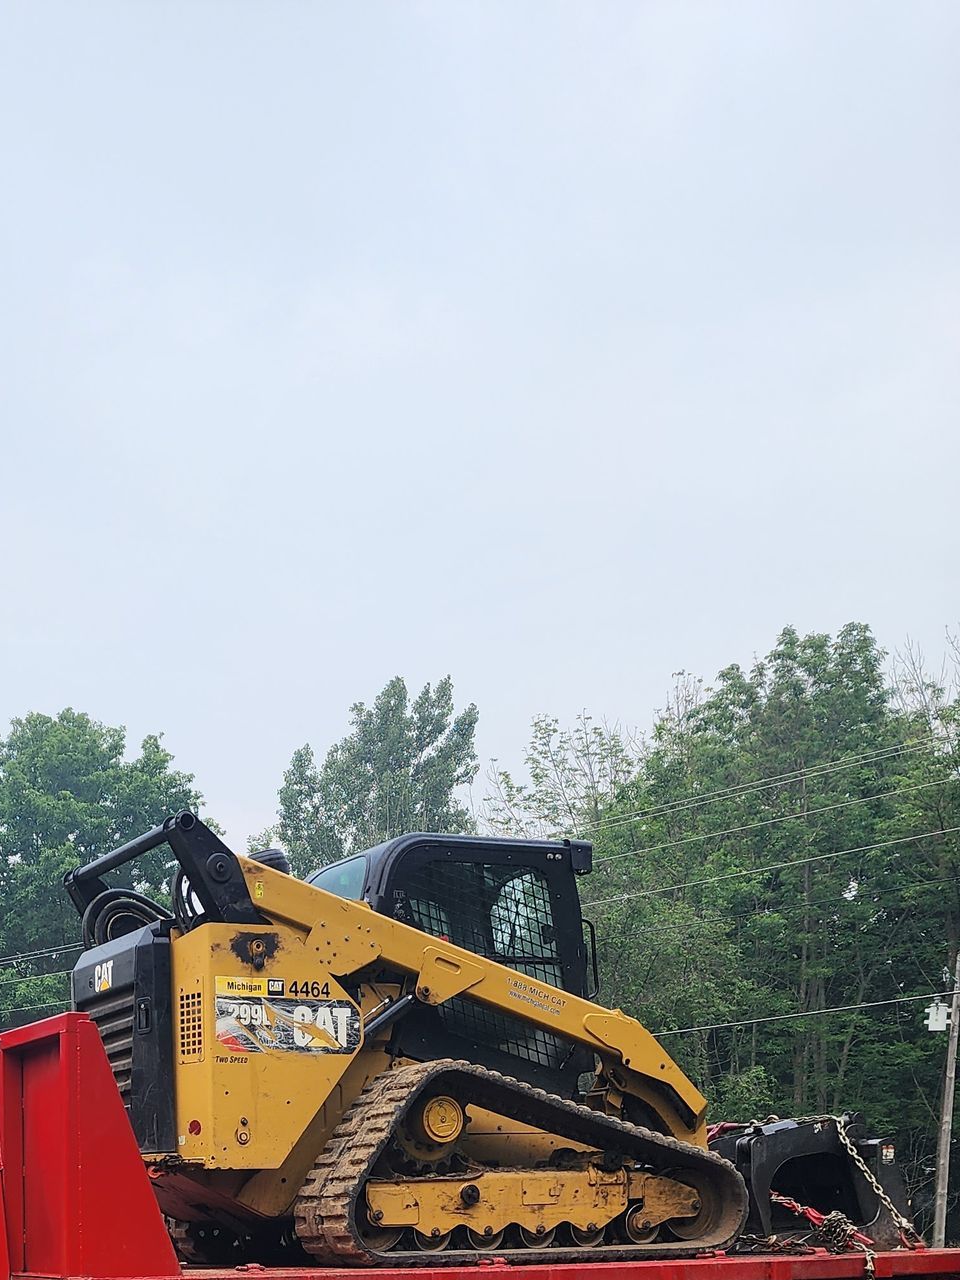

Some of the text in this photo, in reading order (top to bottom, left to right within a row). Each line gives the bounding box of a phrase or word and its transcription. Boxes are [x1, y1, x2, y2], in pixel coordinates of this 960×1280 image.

[95, 960, 113, 992] CAT
[227, 981, 330, 998] Michigan CAT 4464
[529, 986, 549, 1000] MICH
[551, 996, 566, 1007] CAT
[293, 1005, 351, 1047] CAT
